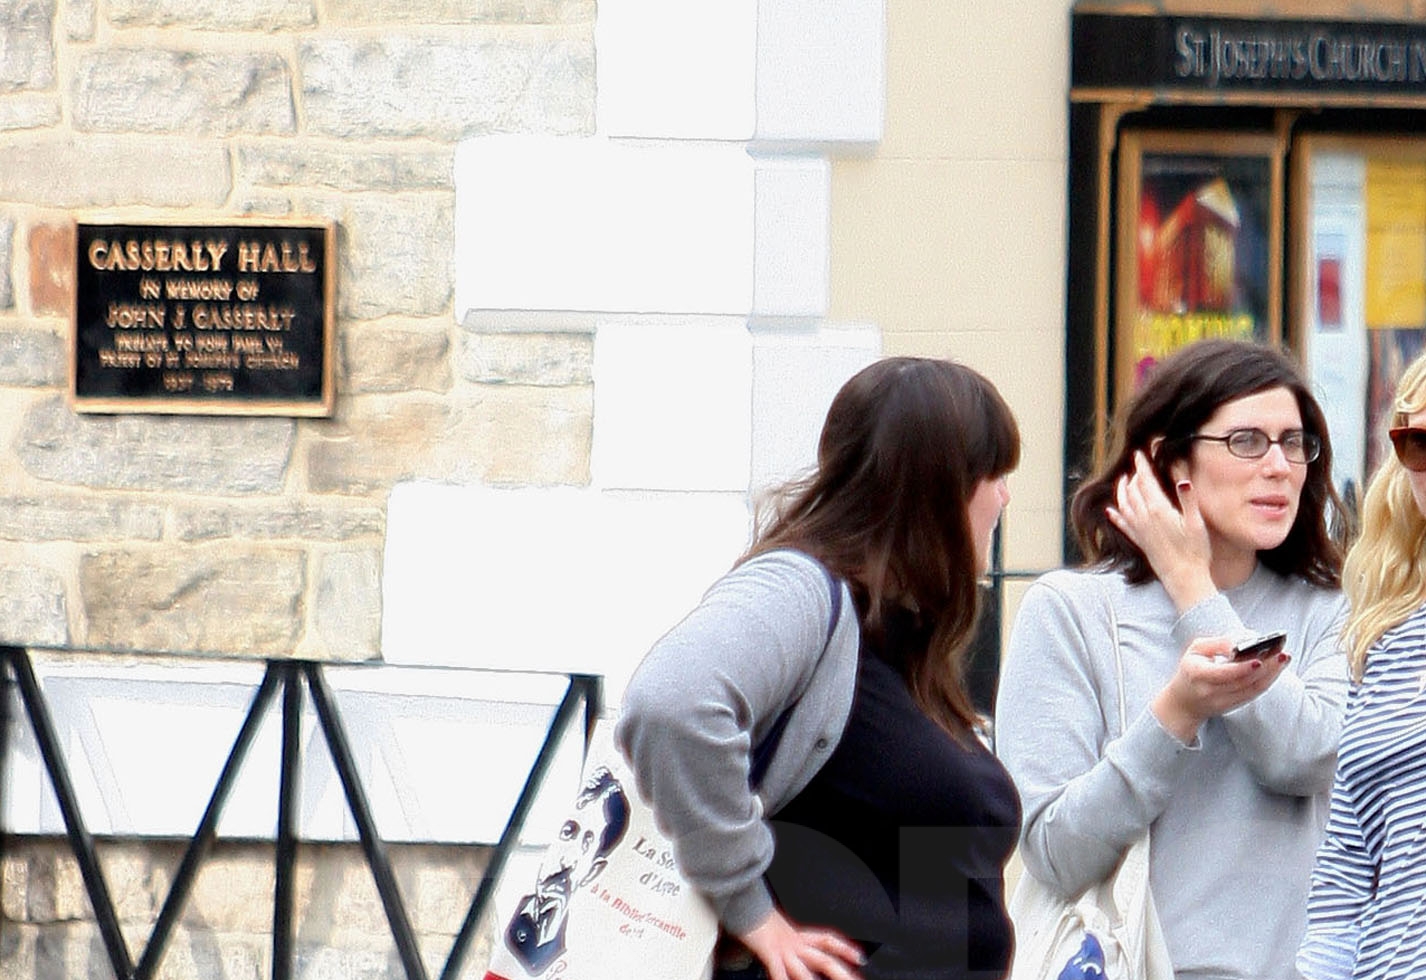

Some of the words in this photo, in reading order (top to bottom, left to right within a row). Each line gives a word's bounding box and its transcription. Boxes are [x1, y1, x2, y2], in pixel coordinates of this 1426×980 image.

[1309, 34, 1405, 82] CHURCH
[89, 240, 228, 271] CASSERLY
[238, 241, 317, 273] HALL
[140, 278, 161, 299] IN
[165, 278, 233, 300] MEMORY
[236, 279, 259, 301] OF
[106, 304, 166, 329] JOHN
[192, 304, 296, 331] CASSERLY
[632, 836, 656, 860] La
